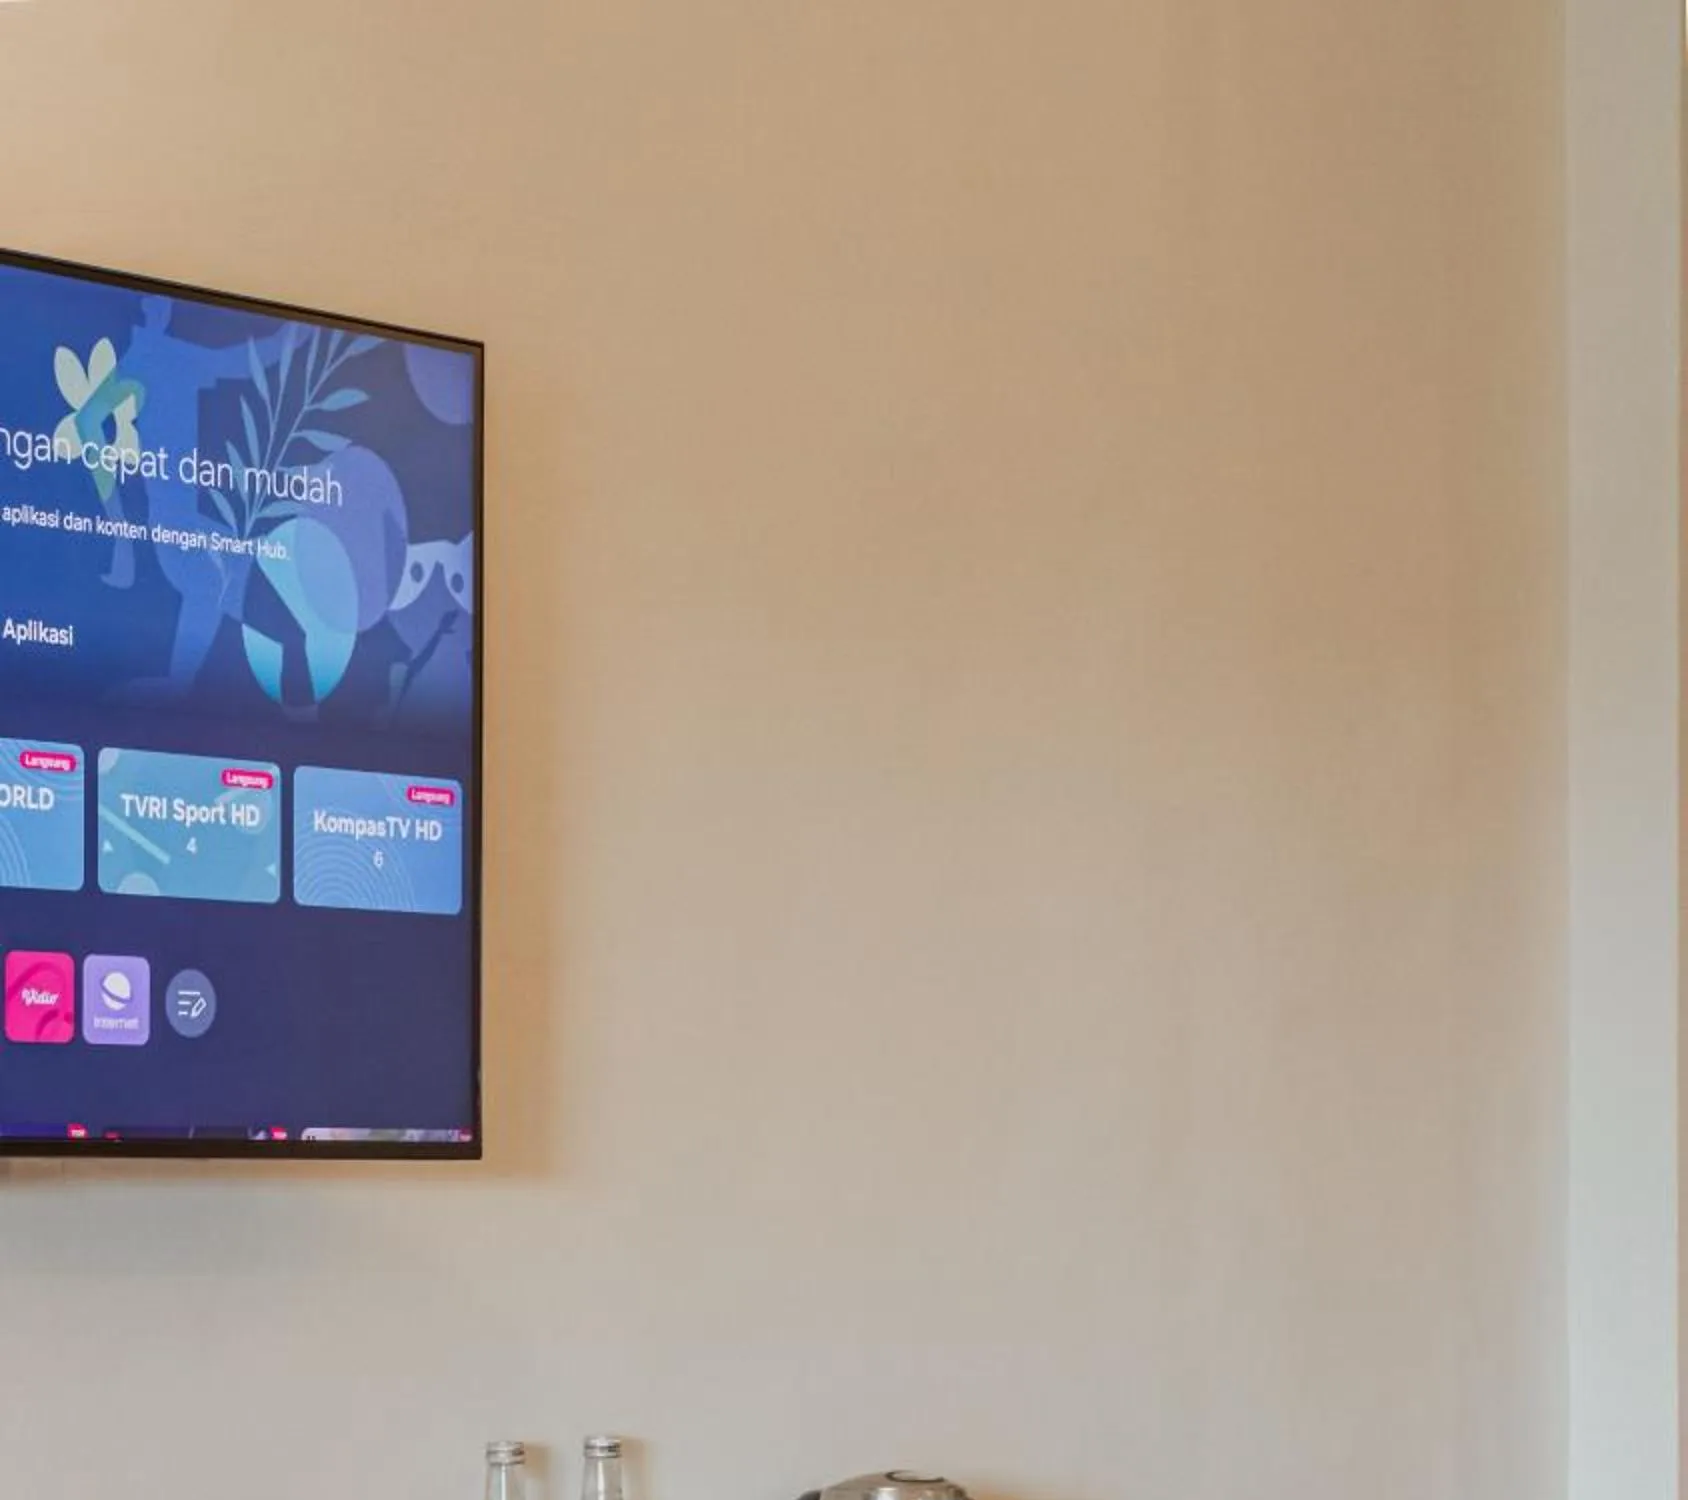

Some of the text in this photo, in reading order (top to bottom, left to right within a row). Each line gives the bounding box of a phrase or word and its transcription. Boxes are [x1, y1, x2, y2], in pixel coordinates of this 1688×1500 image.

[81, 441, 169, 485] cepat
[179, 447, 234, 491] dan
[244, 465, 343, 507] mudah
[1, 504, 291, 560] aplikasi dan konten dengan Smart Hub.
[3, 617, 73, 647] Aplikasi
[120, 793, 261, 828] TVRI Sport HD
[313, 810, 443, 842] KompasTV HD
[185, 837, 198, 854] 4
